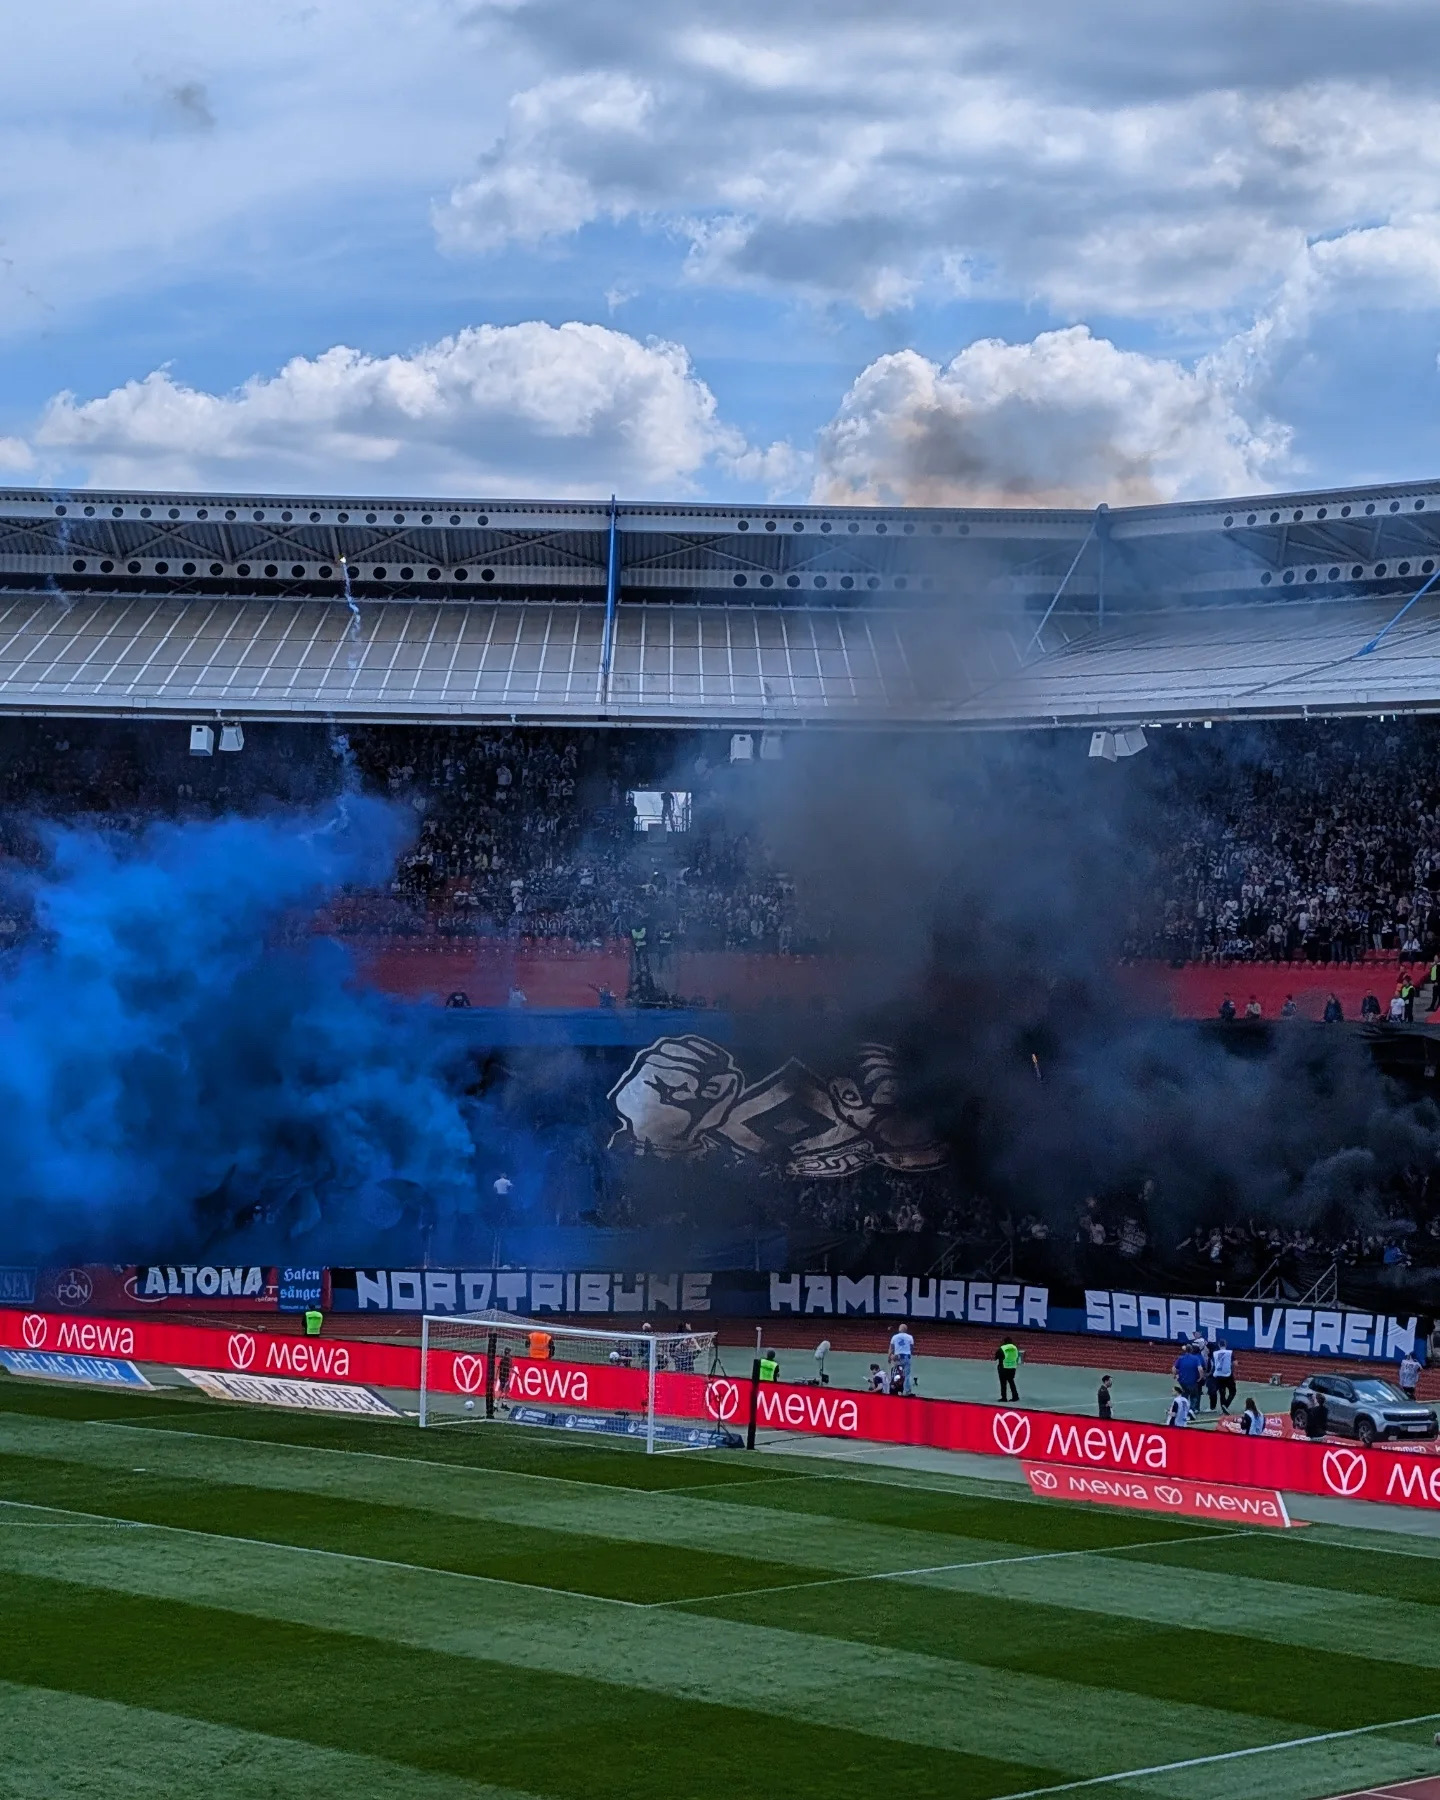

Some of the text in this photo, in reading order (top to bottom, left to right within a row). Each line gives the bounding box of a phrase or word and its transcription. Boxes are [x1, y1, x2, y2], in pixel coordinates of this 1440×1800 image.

[144, 1266, 264, 1296] ALTONA
[283, 1267, 320, 1282] Hafen
[57, 1284, 89, 1299] FCN
[355, 1270, 1418, 1358] NORDTRIBÜNE HAMBURGER SPORT-VEREIN
[4, 1350, 129, 1381] HELMSAUER
[210, 1374, 394, 1413] KULMBACHER
